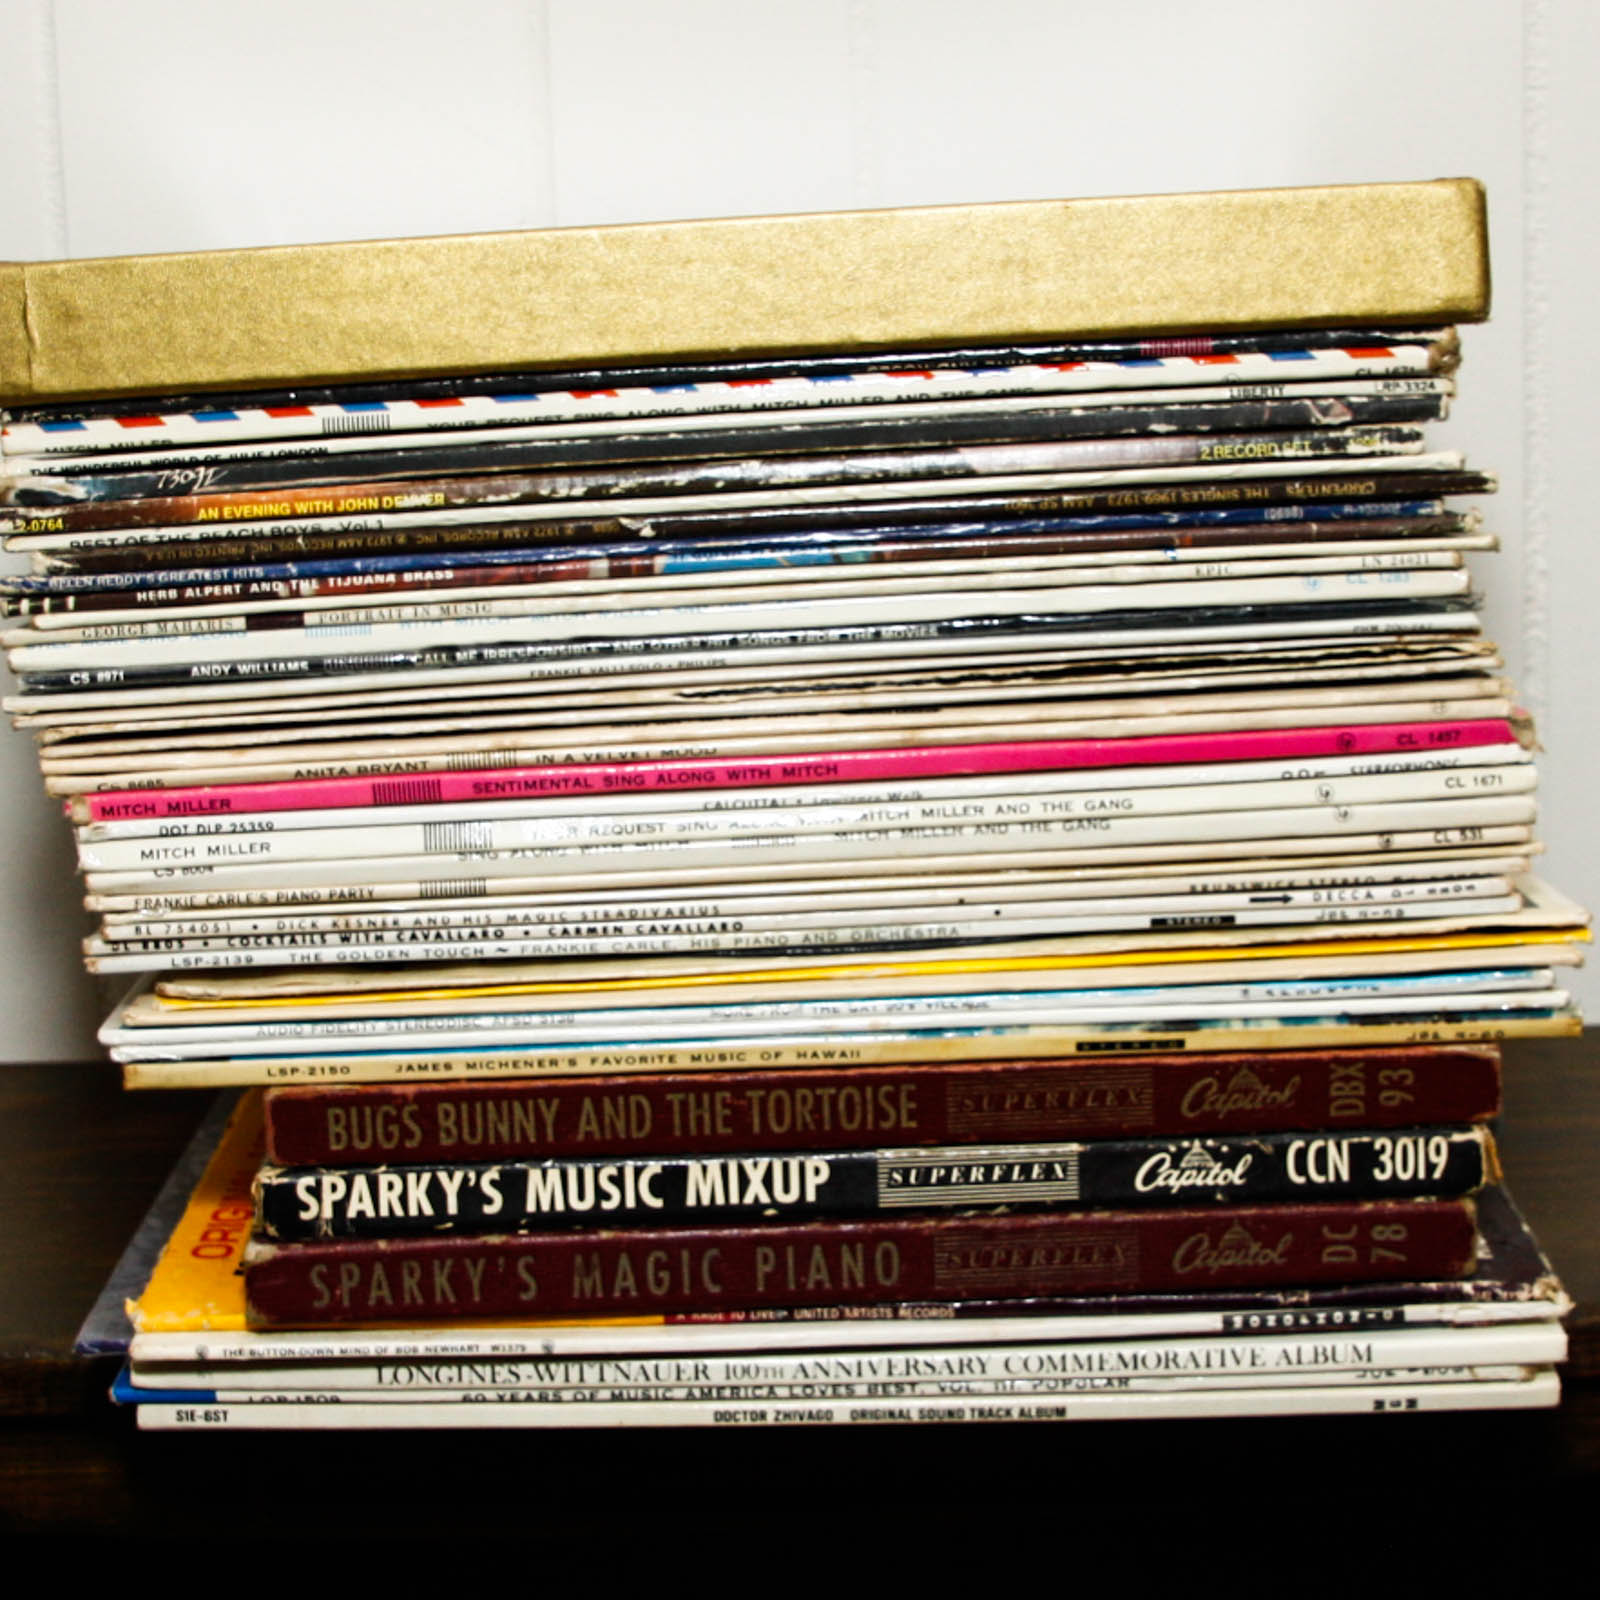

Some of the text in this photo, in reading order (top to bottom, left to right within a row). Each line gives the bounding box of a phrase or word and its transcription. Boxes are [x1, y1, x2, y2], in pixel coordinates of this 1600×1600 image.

[1228, 384, 1286, 399] LIBERTY
[1201, 442, 1278, 460] 2 RECORD
[198, 497, 380, 520] AN EVENING WITH JOHN
[137, 570, 454, 603] HERB ALPERT AND THE TIJUANA BRASS
[160, 568, 230, 583] GREATEST
[234, 567, 264, 579] HITS
[319, 608, 404, 625] PORTRAIT
[412, 606, 432, 619] IN
[439, 602, 494, 617] MUSIC
[82, 618, 234, 639] GEORGE MAHARIS
[70, 660, 309, 685] CS ANDY WILLIAMS
[1396, 732, 1418, 744] CL
[294, 760, 430, 779] ANITA BRYANT
[472, 764, 838, 795] SENTIMENTAL SING ALONG WITH MITCH
[1444, 774, 1504, 789] CL 1671
[100, 798, 232, 818] MITCH MILLER
[921, 805, 984, 819] MILLER
[994, 802, 1030, 816] AND
[1042, 800, 1073, 813] THE
[1084, 797, 1134, 811] GANG
[159, 823, 190, 837] DOT
[974, 822, 1008, 835] AND
[1020, 820, 1052, 833] THE
[1062, 818, 1112, 832] GANG
[1433, 830, 1452, 844] CL
[140, 842, 272, 860] MITCH MILLER
[134, 888, 374, 910] FRANKIE CARLE'S PIANO PARTY
[1312, 890, 1375, 902] DECCA
[134, 925, 153, 936] BL
[276, 919, 318, 931] DICK
[412, 915, 450, 926] AND
[462, 913, 492, 925] HIS
[506, 911, 568, 923] MAGIC
[582, 905, 720, 920] STRADIVARIUS
[227, 921, 744, 949] COCKTAILS WITH CAVALLARO CARMEN CAVALLARO
[172, 927, 959, 967] LSP-2139 THE GOLDEN TOUCH FRANKIE HIS PIANO AND ORCHESTRA
[267, 1049, 861, 1078] LSP-2150 JAMES MICHENER'S FAVORITE MUSIC OF HAWAII
[1181, 1074, 1301, 1118] Capitol
[1330, 1062, 1365, 1117] DBX
[1379, 1068, 1415, 1107] 93
[328, 1084, 918, 1151] BUGS BUNNY AND THE TORTOISE
[1286, 1136, 1449, 1184] CCN 3019
[890, 1162, 1066, 1186] SUPERFLEX
[1134, 1152, 1253, 1194] Capitol
[295, 1159, 831, 1221] SPARKY'S MUSIC MIXUP
[1172, 1231, 1294, 1275] Capitol
[1321, 1225, 1358, 1264] DC
[1370, 1224, 1409, 1264] 78
[309, 1241, 900, 1309] SPARKY'S MAGIC PIANO
[793, 1307, 840, 1321] UNITED
[844, 1306, 893, 1320] ARTISTS
[222, 1347, 243, 1358] THE
[339, 1345, 370, 1355] MIND
[375, 1345, 389, 1355] OF
[425, 1343, 480, 1354] NEWHART
[791, 1354, 988, 1380] ANNIVERSARY
[1004, 1348, 1266, 1375] COMMEMORATIVE
[1276, 1343, 1373, 1366] ALBUM
[496, 1391, 563, 1402] YEARS
[573, 1390, 599, 1402] OF
[610, 1388, 674, 1402] MUSIC
[685, 1386, 779, 1401] AMERICA
[788, 1384, 856, 1399] LOVES
[713, 1406, 1067, 1423] DOCTOR ZHIVAGO ORIGINAL SOUND TRACK ALBUM
